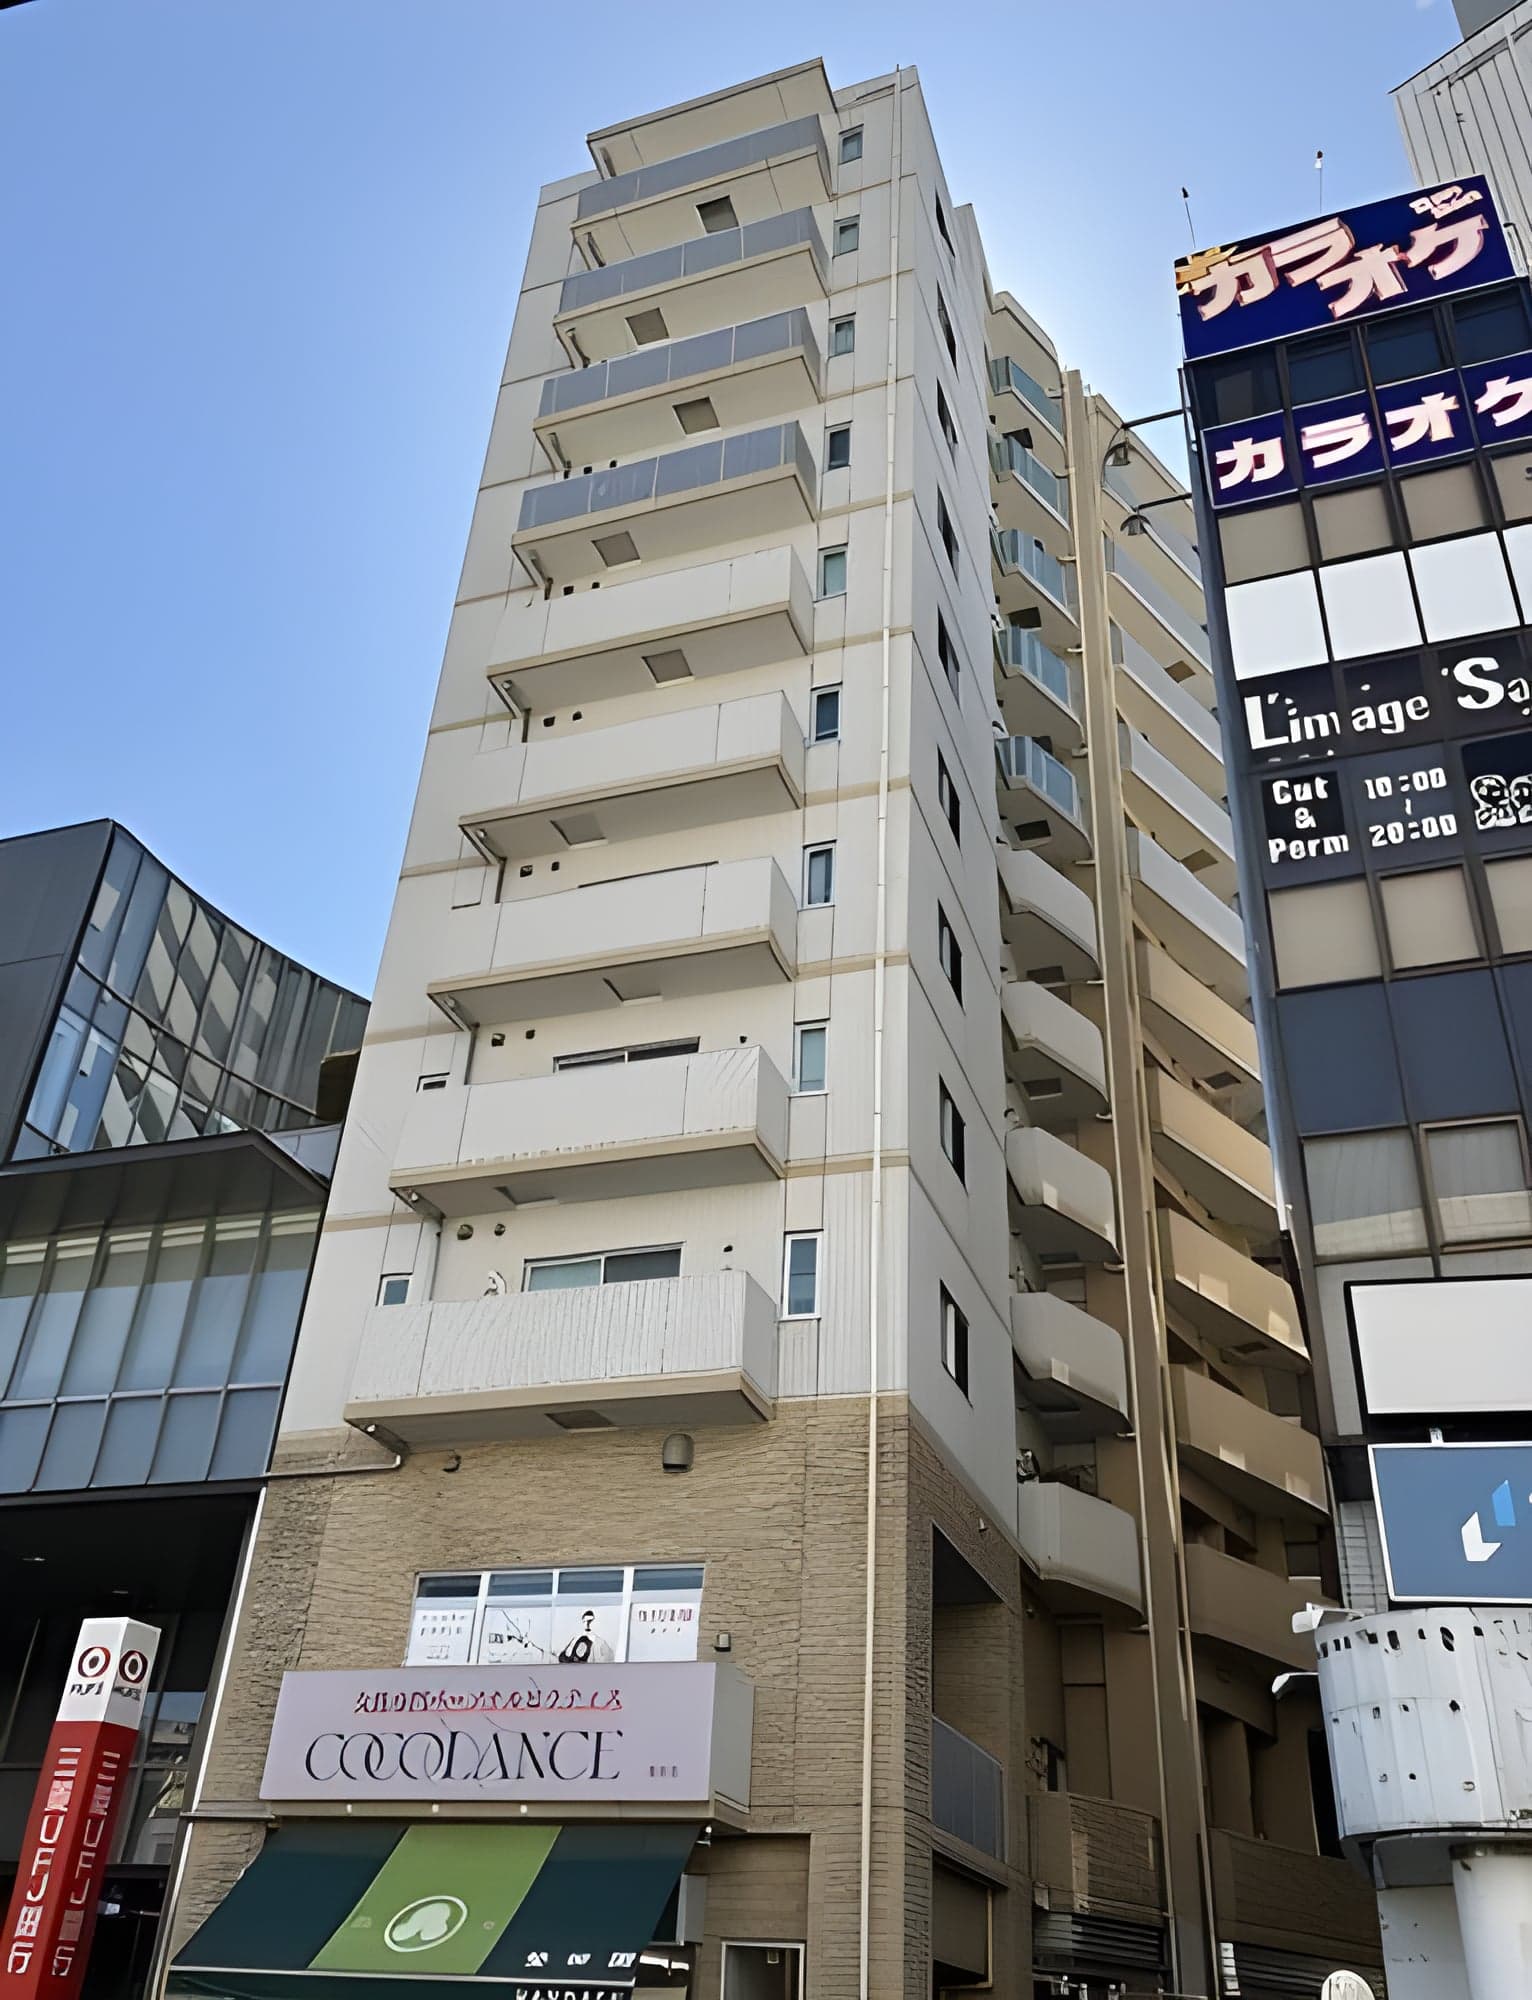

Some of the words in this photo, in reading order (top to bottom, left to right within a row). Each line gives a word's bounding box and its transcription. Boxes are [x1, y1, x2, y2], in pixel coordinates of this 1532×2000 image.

[1190, 213, 1489, 322] カラオケ
[1215, 375, 1532, 490] カラオケ
[1272, 776, 1329, 805] Cut
[1364, 767, 1447, 799] 10:00
[1294, 807, 1317, 829] &
[1368, 813, 1458, 848] 20:00
